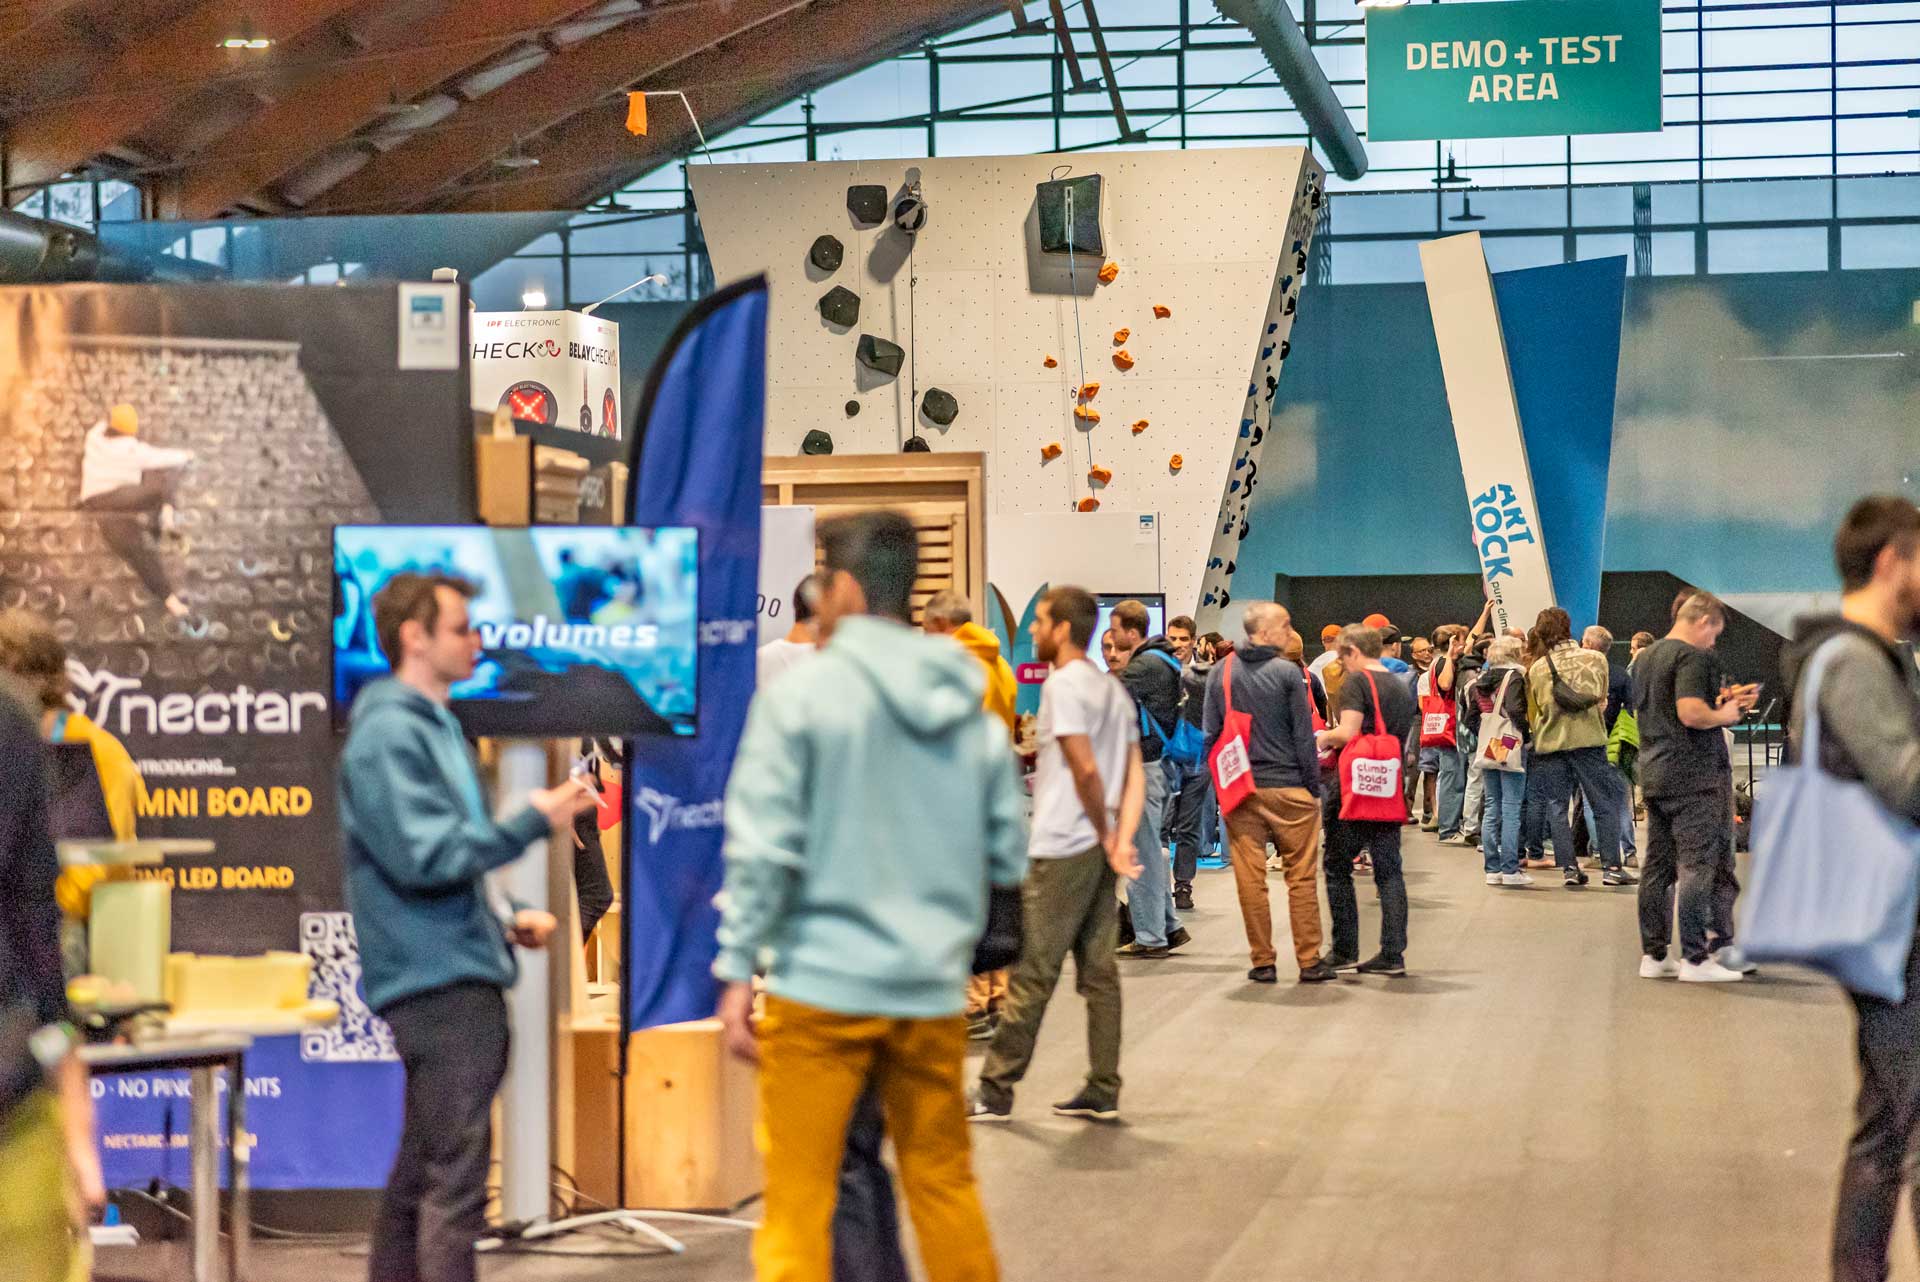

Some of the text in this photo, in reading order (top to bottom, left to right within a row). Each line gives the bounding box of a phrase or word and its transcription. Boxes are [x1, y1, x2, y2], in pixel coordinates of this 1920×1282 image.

[1406, 34, 1623, 70] DEMO + TEST
[1467, 72, 1559, 103] AREA
[504, 318, 561, 328] ELECTRONIC
[471, 341, 538, 360] HECK
[1491, 581, 1503, 606] pure
[480, 614, 660, 649] volumes
[119, 684, 327, 735] nectar
[137, 786, 313, 817] MNI BOARD
[179, 866, 218, 890] LED
[221, 865, 295, 889] BOARD
[118, 1078, 149, 1098] NO
